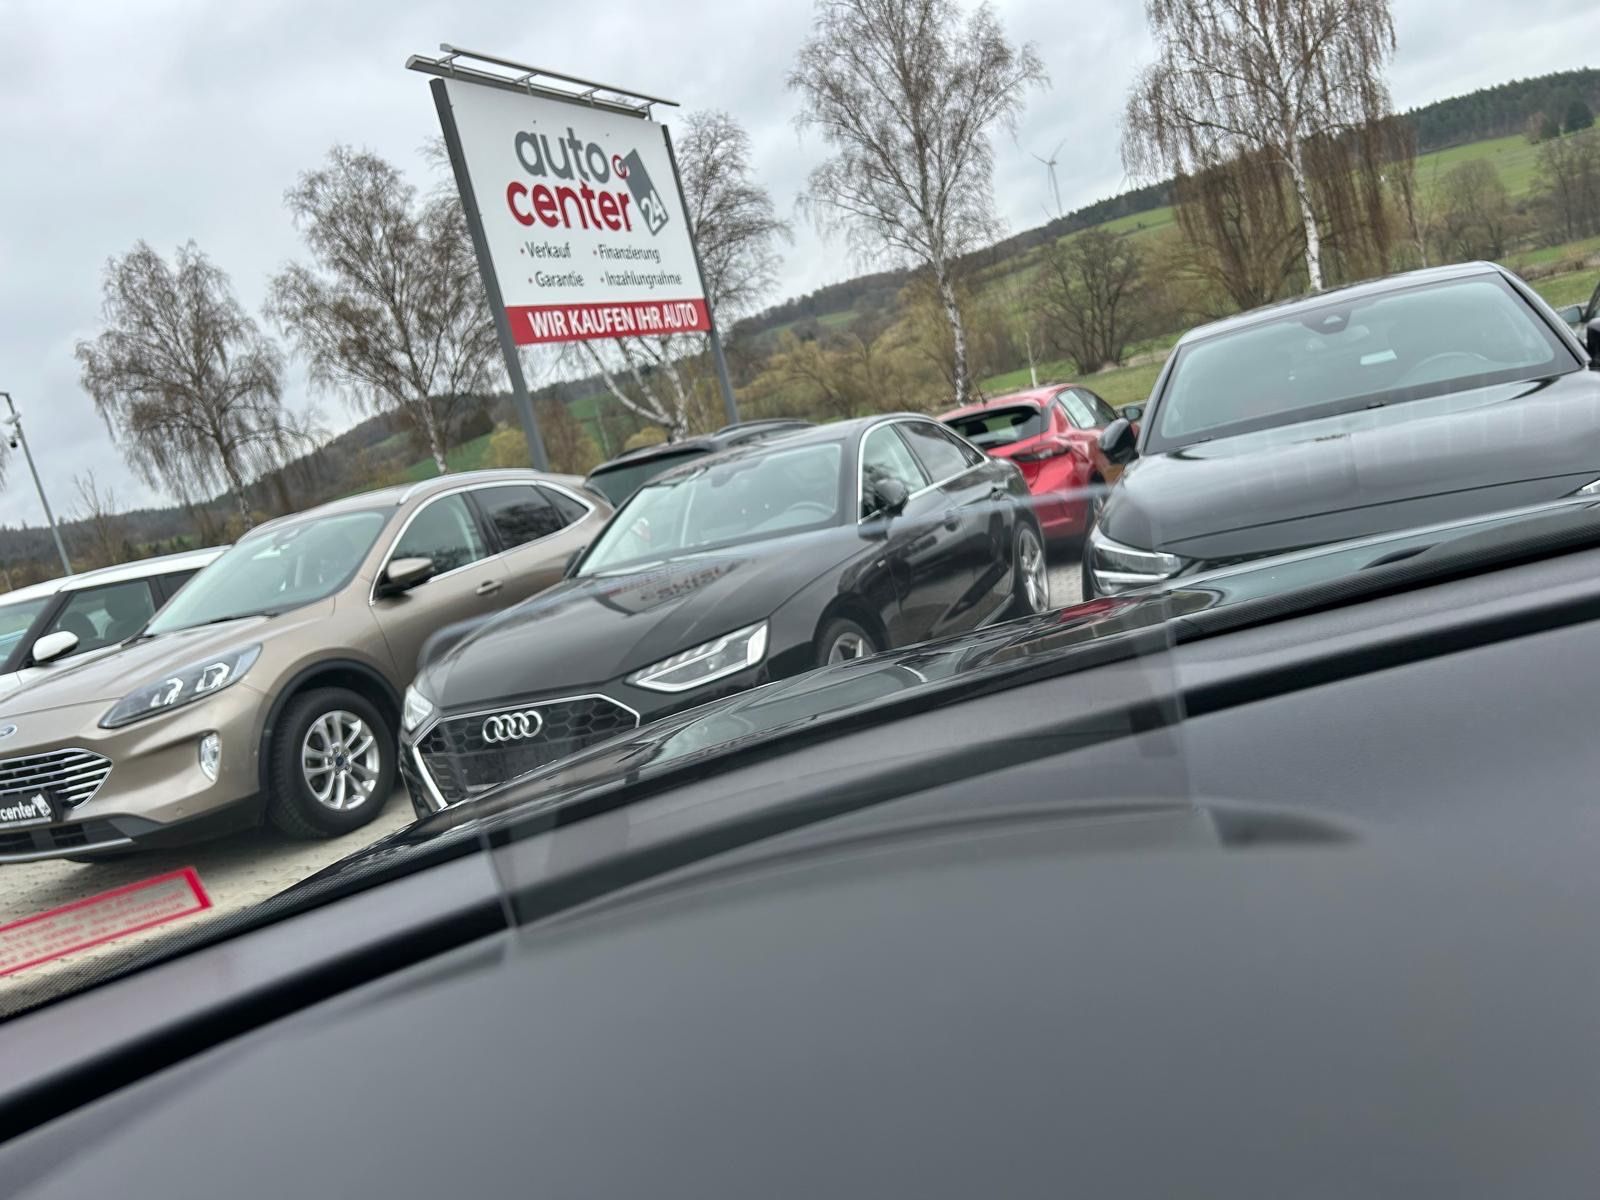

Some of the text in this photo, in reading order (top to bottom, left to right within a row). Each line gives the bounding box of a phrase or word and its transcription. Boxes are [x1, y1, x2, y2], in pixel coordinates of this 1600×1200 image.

[514, 127, 610, 184] auto
[507, 181, 632, 232] center
[640, 189, 668, 232] 24
[525, 241, 572, 259] Verkauf
[597, 243, 662, 264] Finanzierung
[534, 271, 584, 288] Garantie
[604, 269, 682, 289] Inzahlungnahme
[526, 302, 699, 338] WIR KAUFEN IHR AUTO
